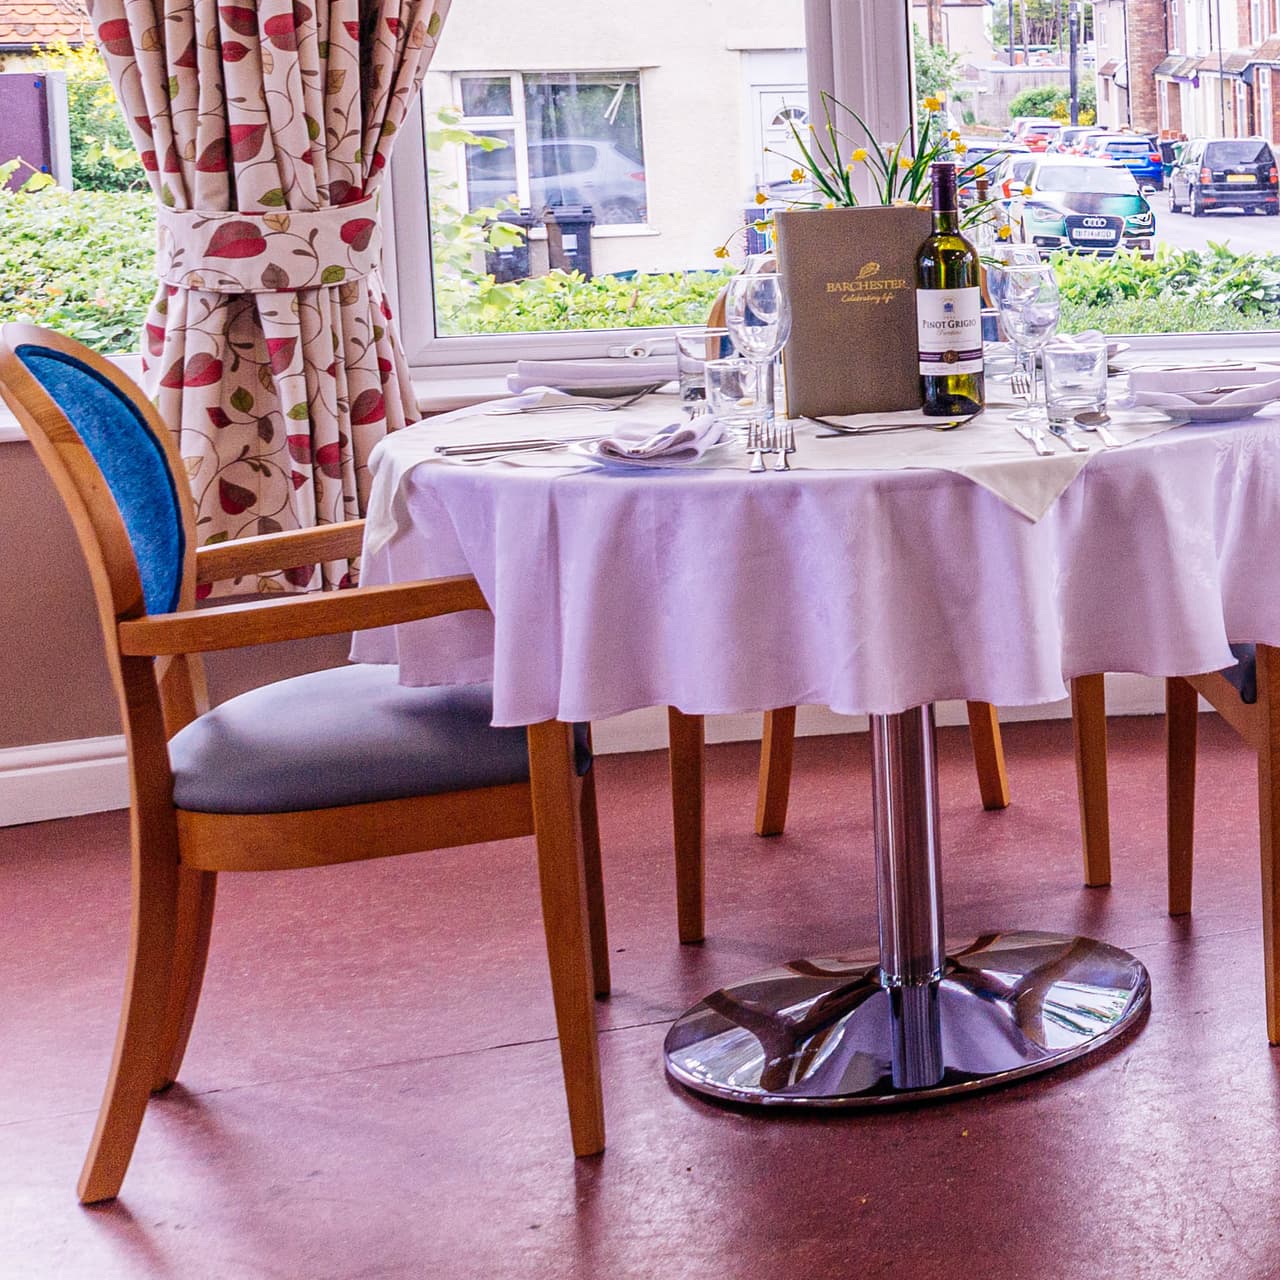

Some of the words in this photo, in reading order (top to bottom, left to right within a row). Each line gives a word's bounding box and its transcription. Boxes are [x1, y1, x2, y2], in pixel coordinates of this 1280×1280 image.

[826, 279, 907, 293] BARCHESTER
[922, 319, 946, 328] PINOT
[948, 319, 977, 328] GRIGIO
